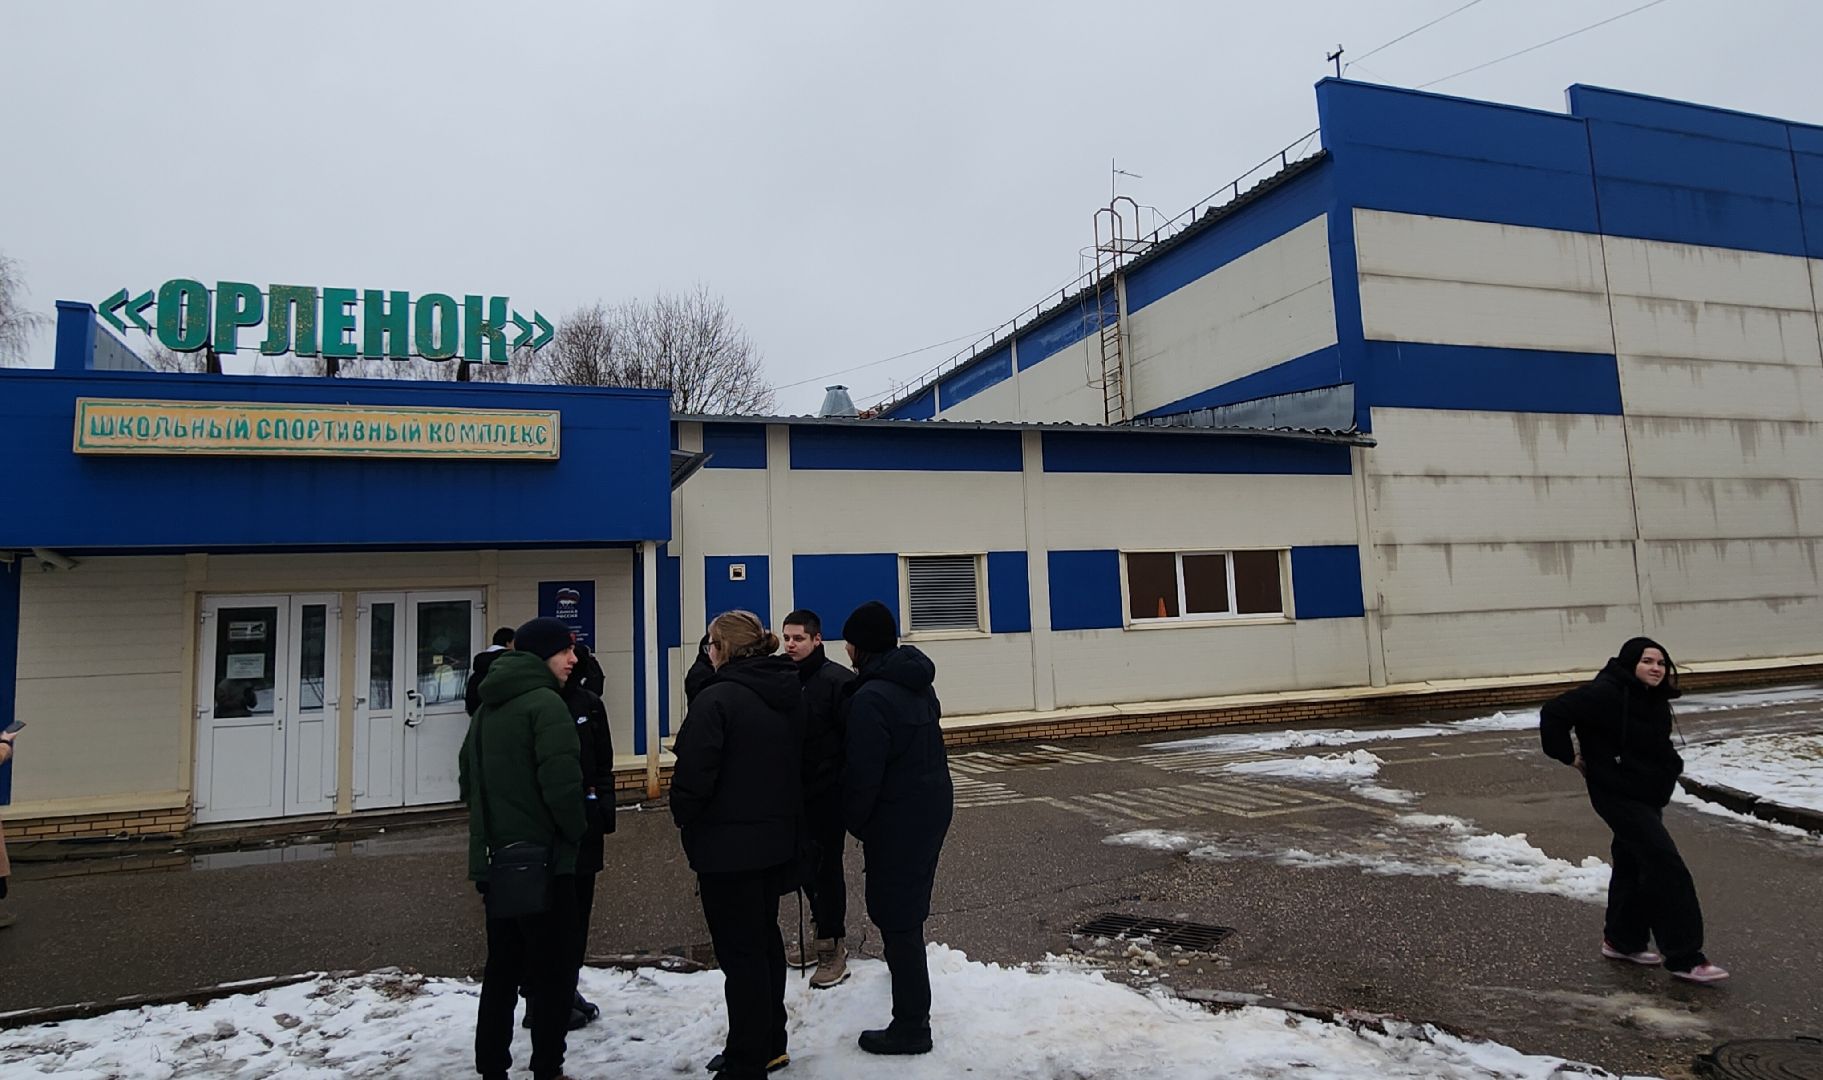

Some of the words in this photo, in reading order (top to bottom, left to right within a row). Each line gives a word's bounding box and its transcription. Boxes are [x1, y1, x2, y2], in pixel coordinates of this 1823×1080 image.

[98, 278, 554, 365] «ОРЛЕНОК»
[89, 412, 252, 441] ШКОЛЬНЫЙ
[256, 417, 422, 444] СПОРТИВНЫЙ
[427, 420, 548, 447] КОМПЛЕКС
